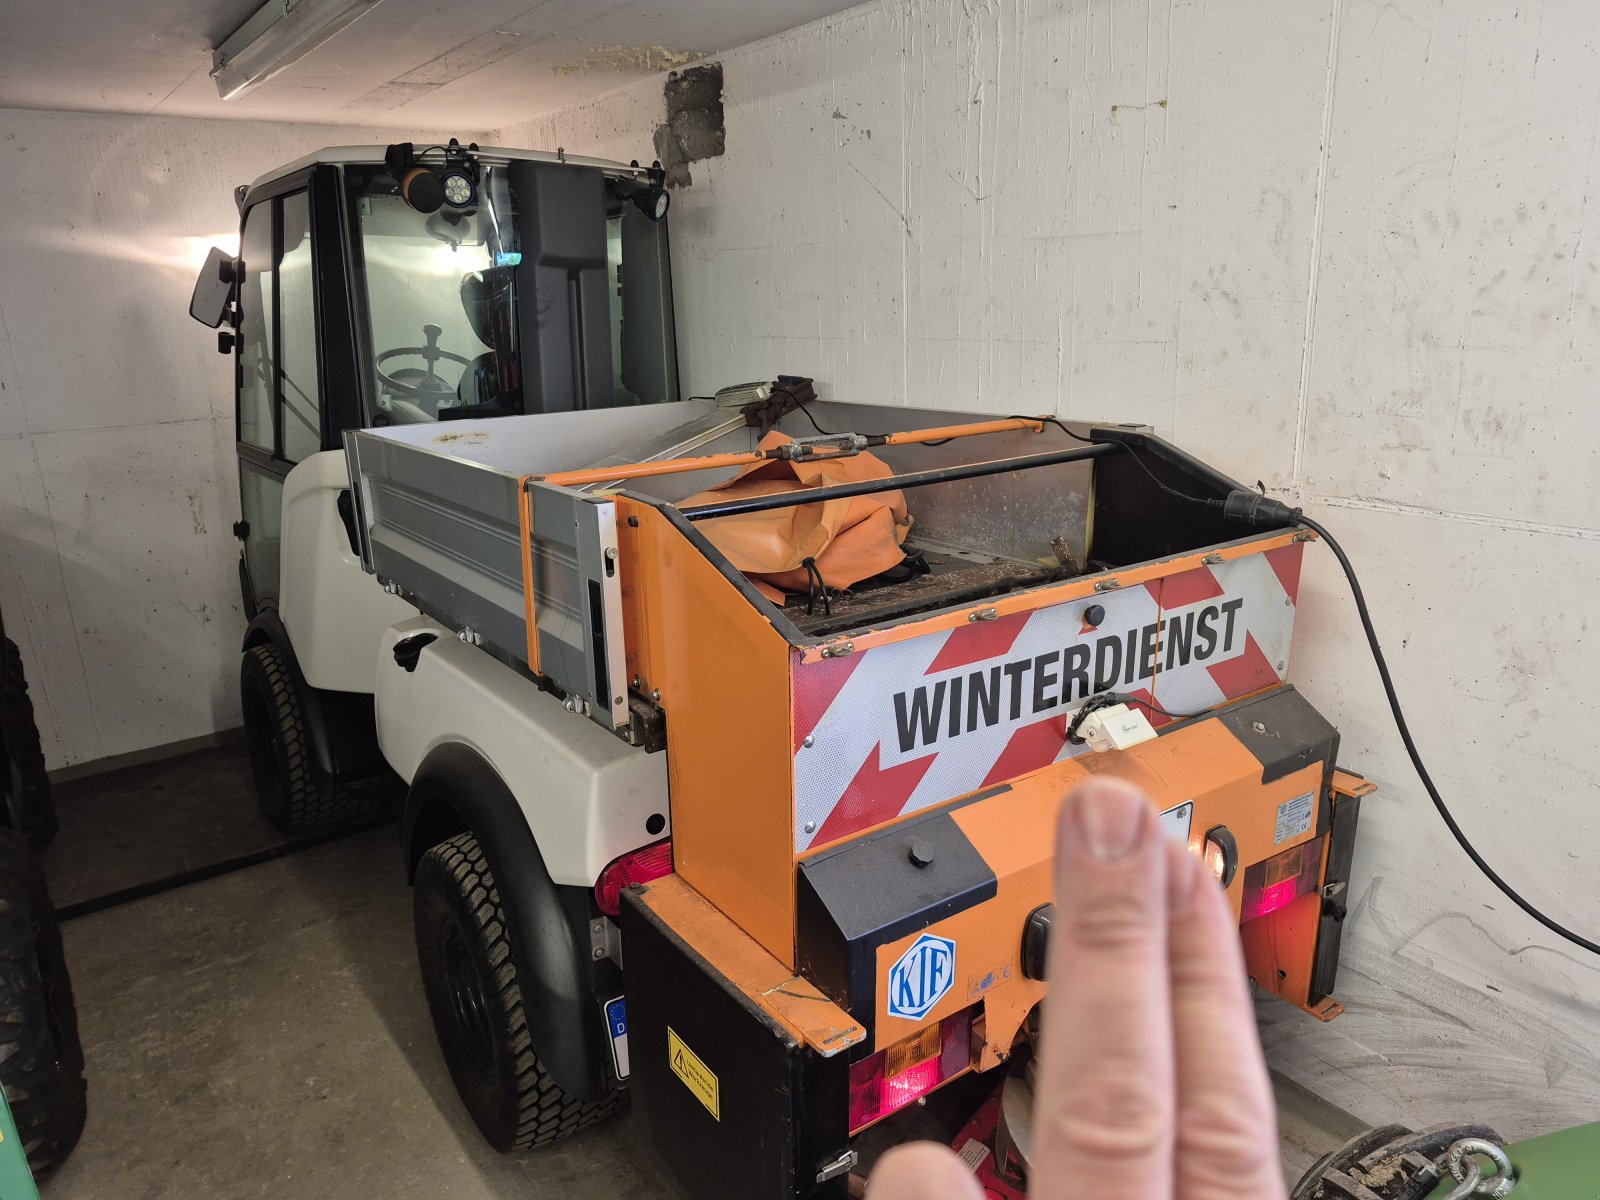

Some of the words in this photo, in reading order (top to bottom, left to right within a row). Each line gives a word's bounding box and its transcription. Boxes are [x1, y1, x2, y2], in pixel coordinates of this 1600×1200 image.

[893, 598, 1243, 753] WINTERDIENST
[898, 946, 948, 1008] KIF
[617, 1022, 625, 1034] D
